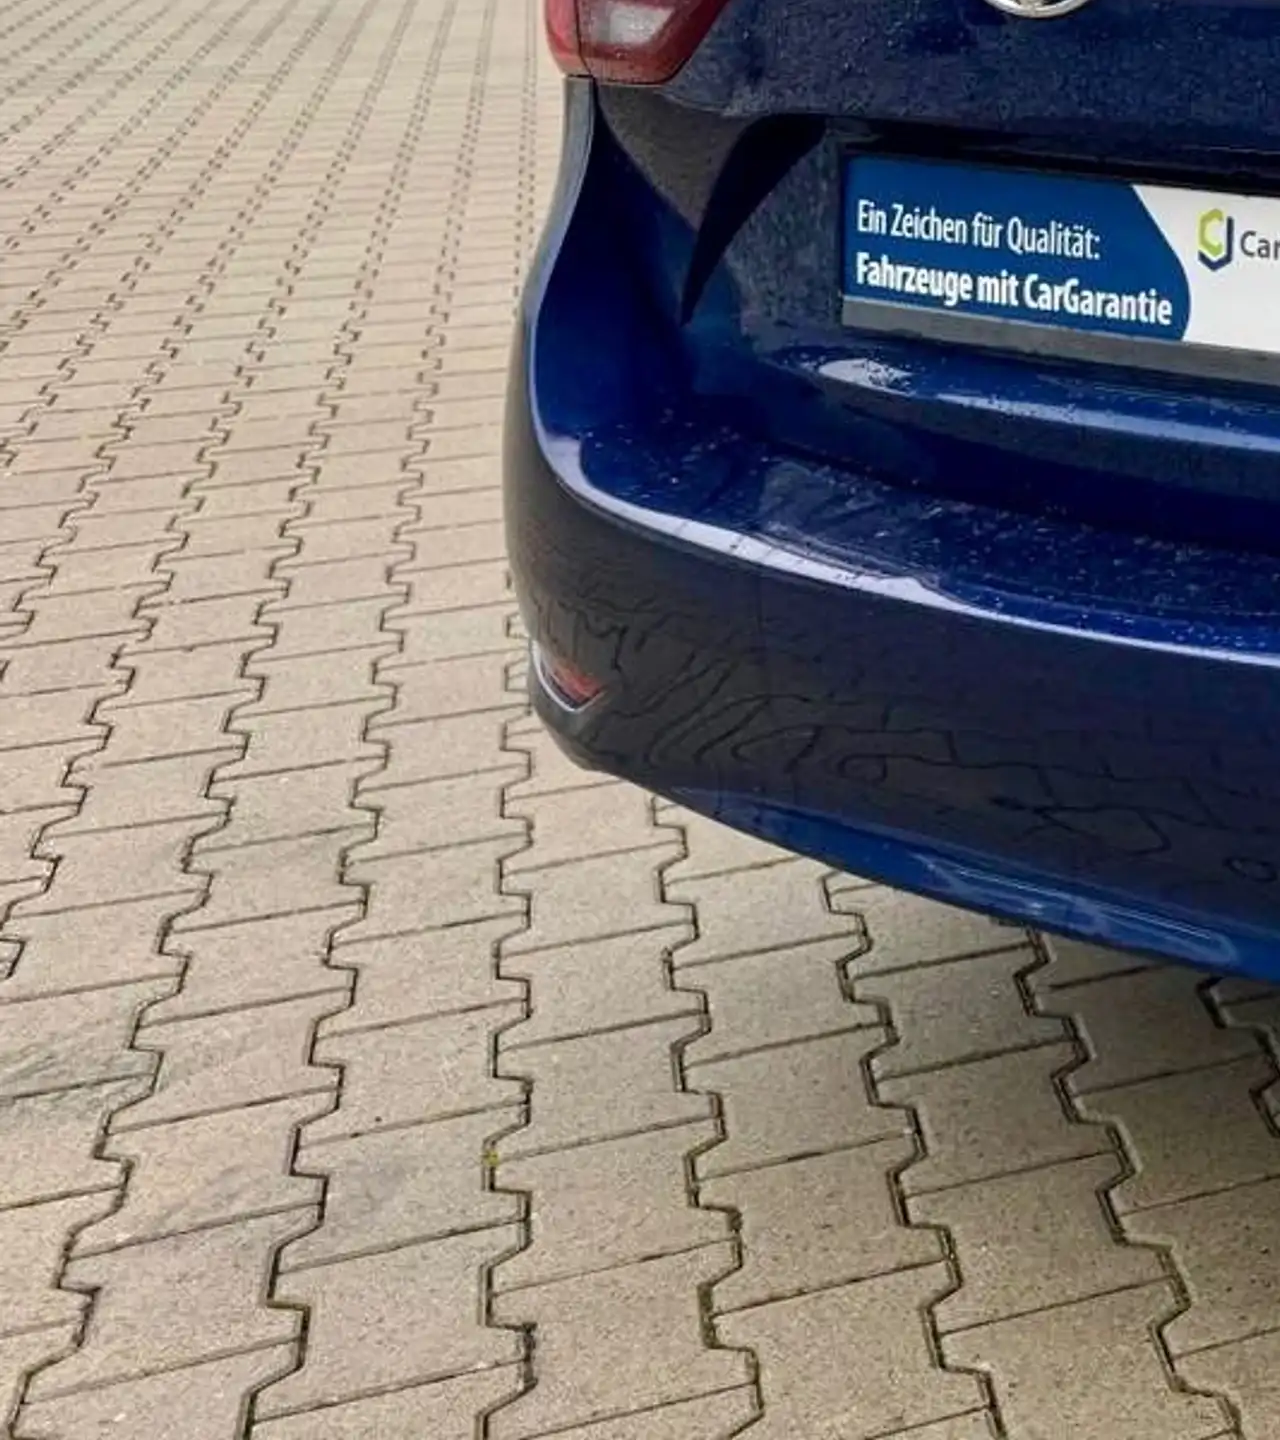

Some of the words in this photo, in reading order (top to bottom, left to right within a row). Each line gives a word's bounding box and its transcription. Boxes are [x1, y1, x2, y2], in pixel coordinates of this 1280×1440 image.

[857, 199, 887, 235] Ein
[890, 204, 968, 245] Zeichen
[972, 211, 1003, 249] für
[1007, 216, 1101, 259] Qualität:
[856, 252, 973, 306] Fahrzeuge
[977, 269, 1019, 308] mit
[1024, 274, 1174, 326] CarGarantie
